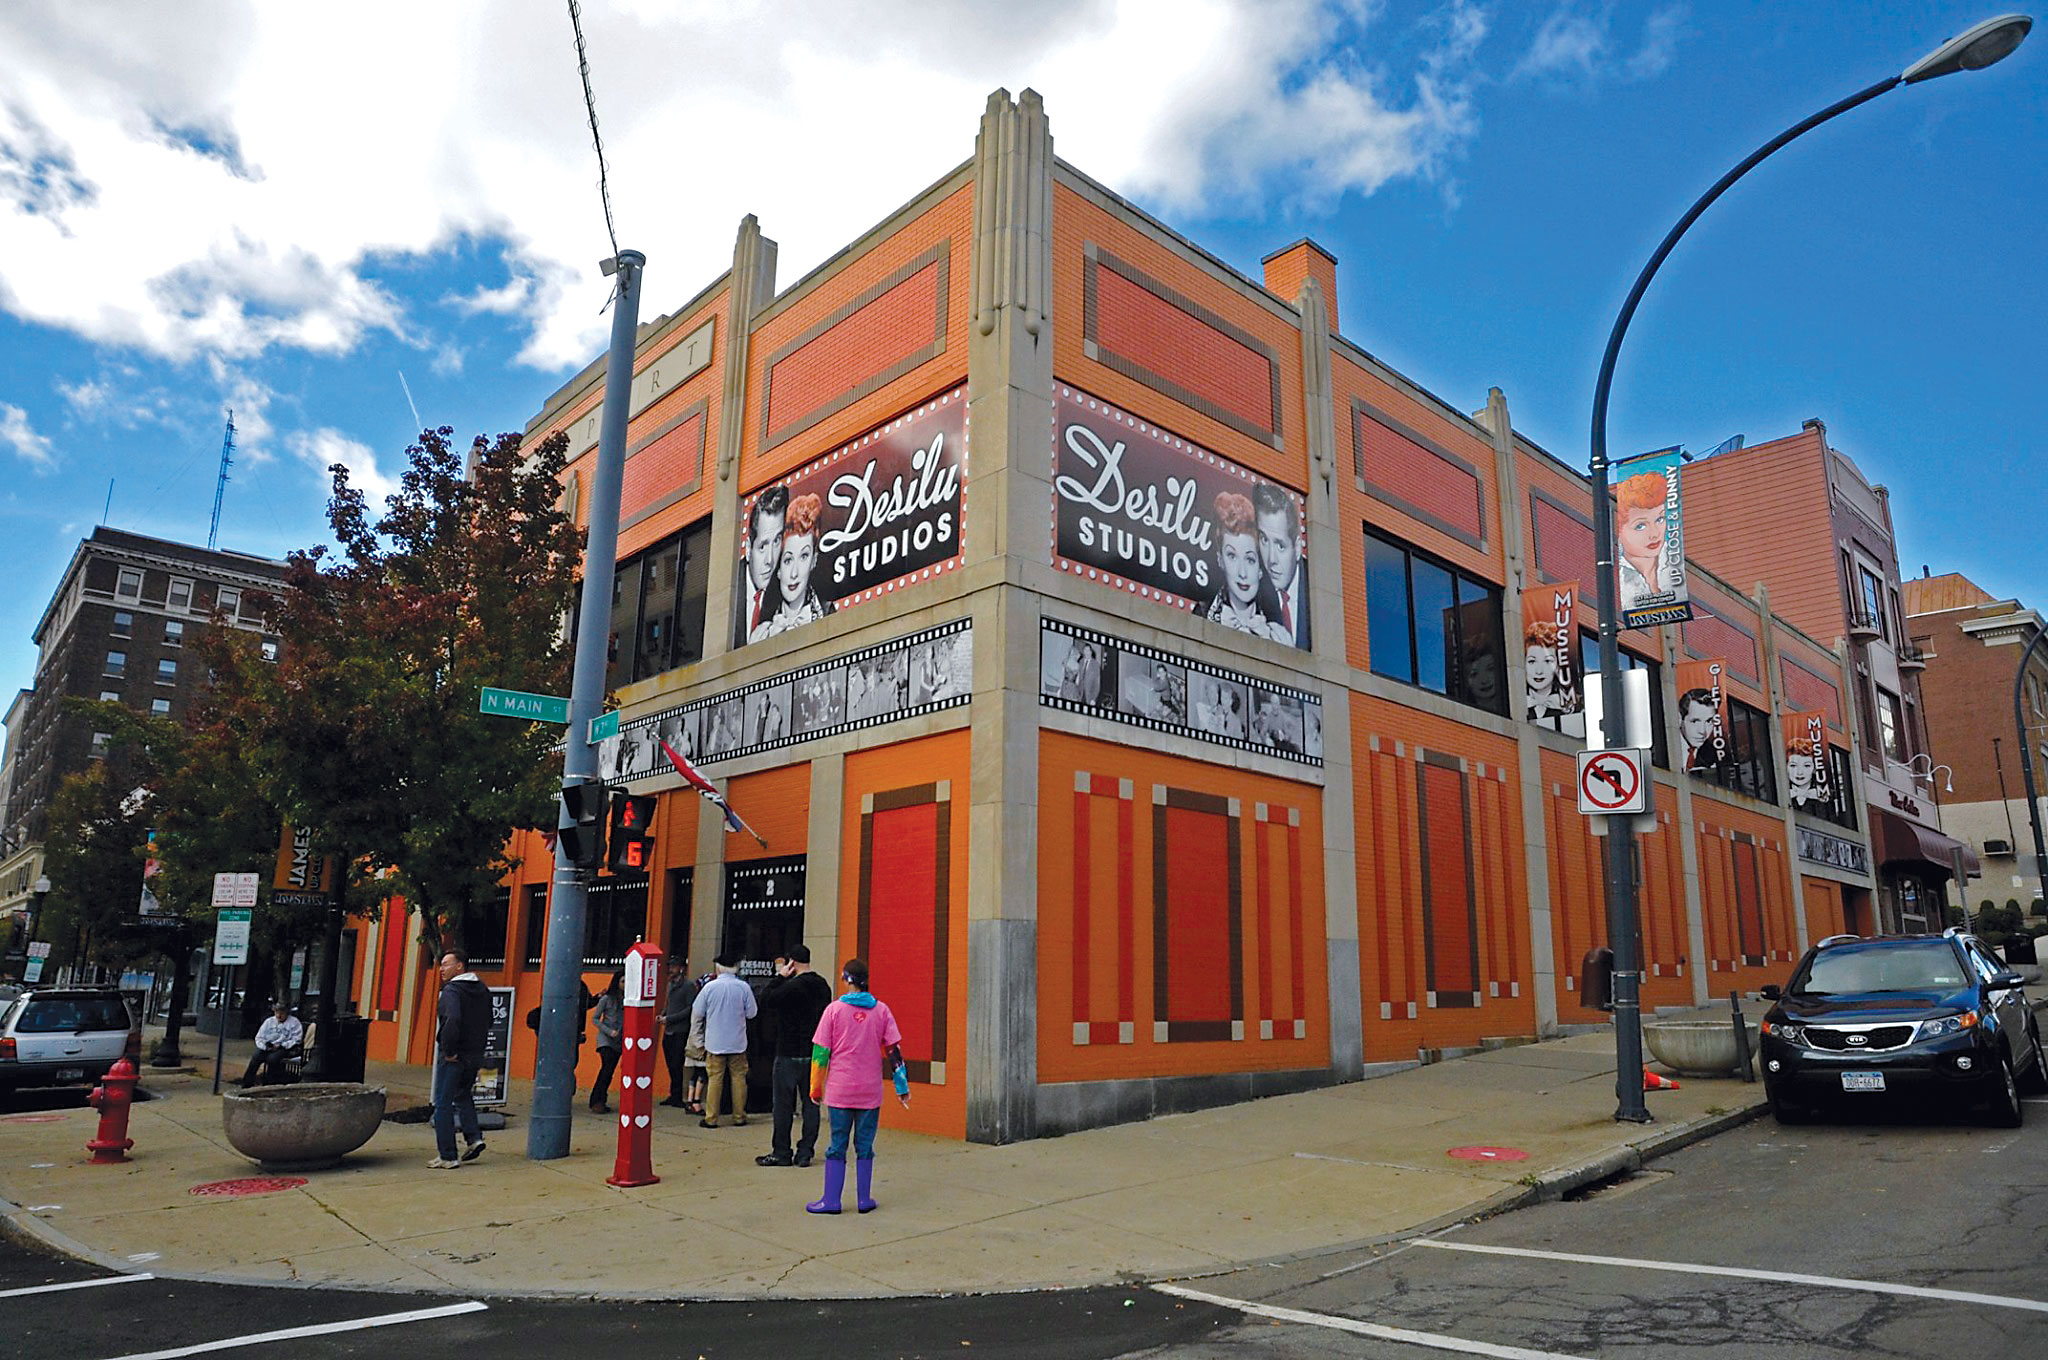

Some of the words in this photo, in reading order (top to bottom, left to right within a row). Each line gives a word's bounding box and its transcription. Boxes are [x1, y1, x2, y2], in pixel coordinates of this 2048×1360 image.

[819, 432, 959, 553] Desilu
[1055, 424, 1212, 551] Desilu
[1665, 465, 1679, 510] FUNNY
[1666, 511, 1679, 522] &
[833, 512, 952, 584] STUDIOS
[1079, 516, 1210, 587] STUDIOS
[1667, 522, 1682, 568] CLOSE
[1670, 569, 1684, 587] UP
[1554, 588, 1577, 707] MUSEUM
[487, 694, 498, 708] N
[504, 696, 543, 713] MAIN
[1709, 663, 1721, 710] GIFT
[1713, 714, 1726, 762] SHOP
[1807, 716, 1831, 797] MUSEUM
[288, 825, 312, 887] JAMES
[627, 841, 642, 867] 6
[766, 879, 775, 897] 2
[647, 960, 655, 996] FIRE
